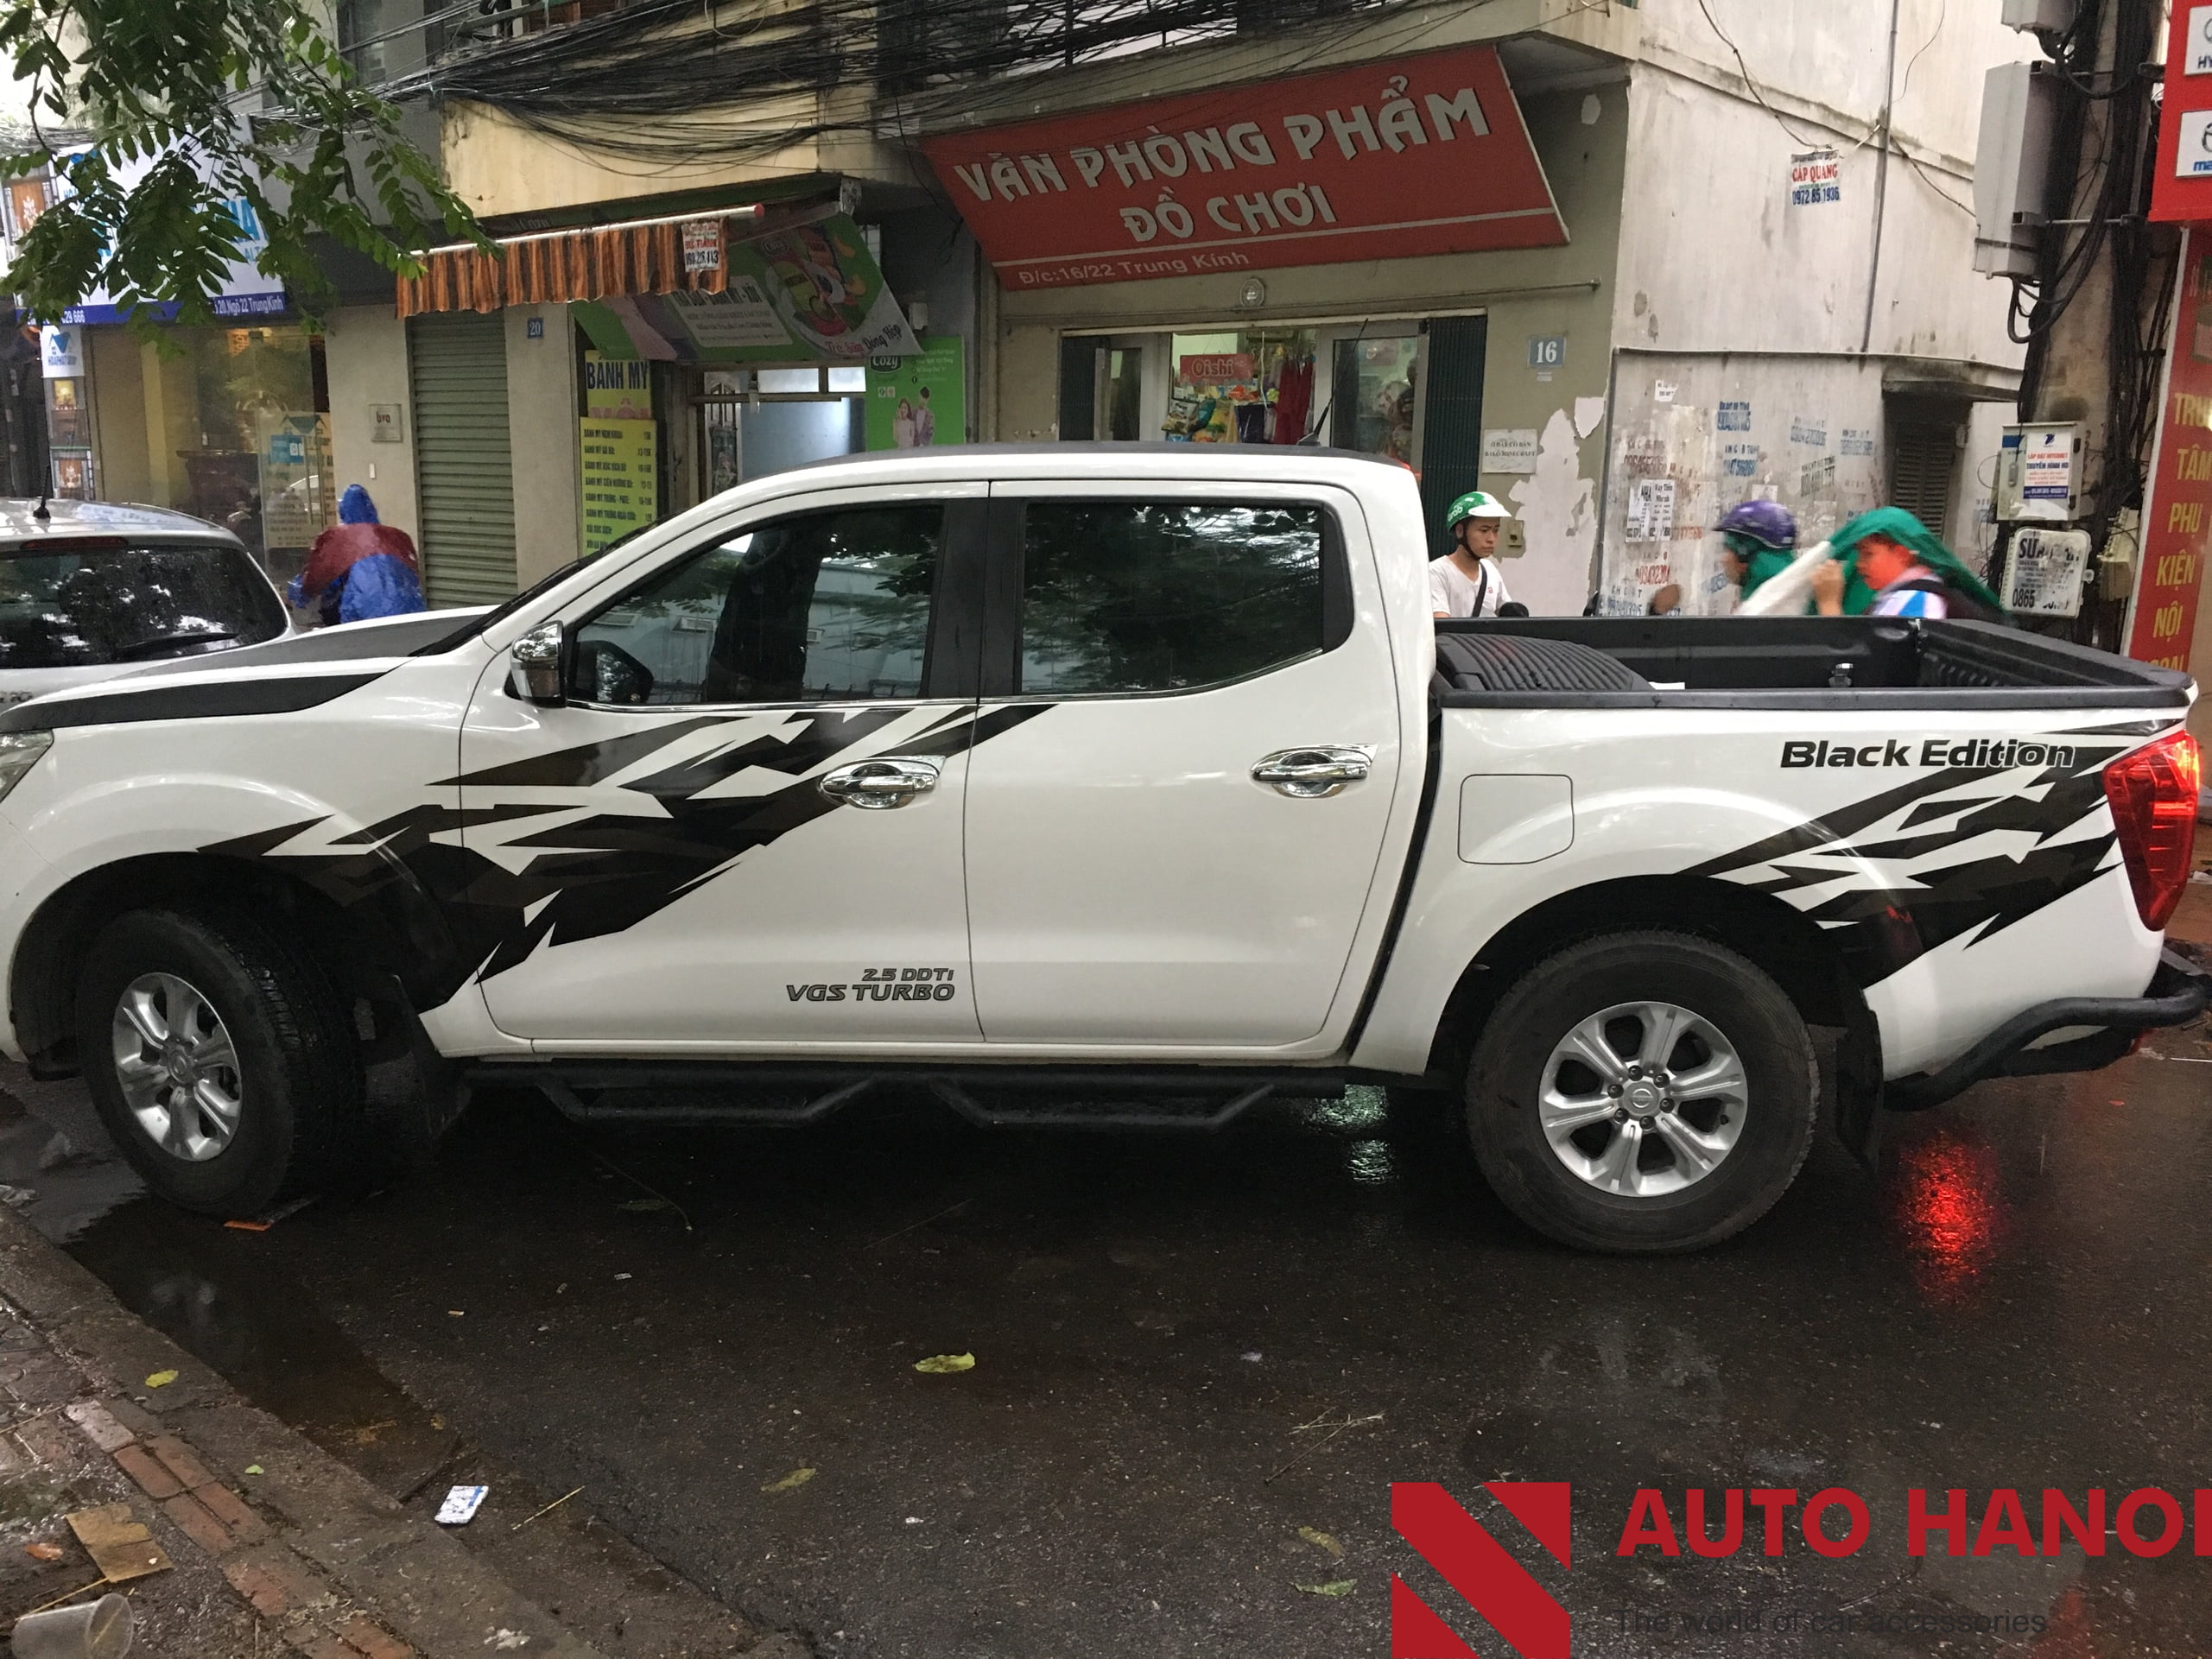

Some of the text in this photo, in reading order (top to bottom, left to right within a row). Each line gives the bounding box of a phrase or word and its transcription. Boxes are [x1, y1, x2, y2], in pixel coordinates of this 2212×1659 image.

[954, 75, 1491, 202] VĂN PHÒNG PHẨM
[1810, 164, 1838, 183] QUANG
[1792, 190, 1810, 205] 0972
[1822, 186, 1840, 202] 1936
[1119, 182, 1339, 243] ĐỒ CHƠI
[1118, 258, 1188, 276] Trung
[1192, 250, 1251, 269] Kính
[239, 297, 249, 313] 22
[529, 321, 542, 336] 20
[1536, 340, 1557, 364] 16
[1191, 358, 1235, 377] Oishi
[2177, 443, 2212, 480] TÂM
[2167, 502, 2203, 539] PHỤ
[2155, 548, 2196, 591] KIỆN
[2012, 588, 2036, 608] 0865
[2152, 600, 2183, 643] NỘI
[1780, 738, 2076, 769] Black Edition
[861, 968, 897, 981] 2.5
[786, 984, 955, 1002] VGS TURBO
